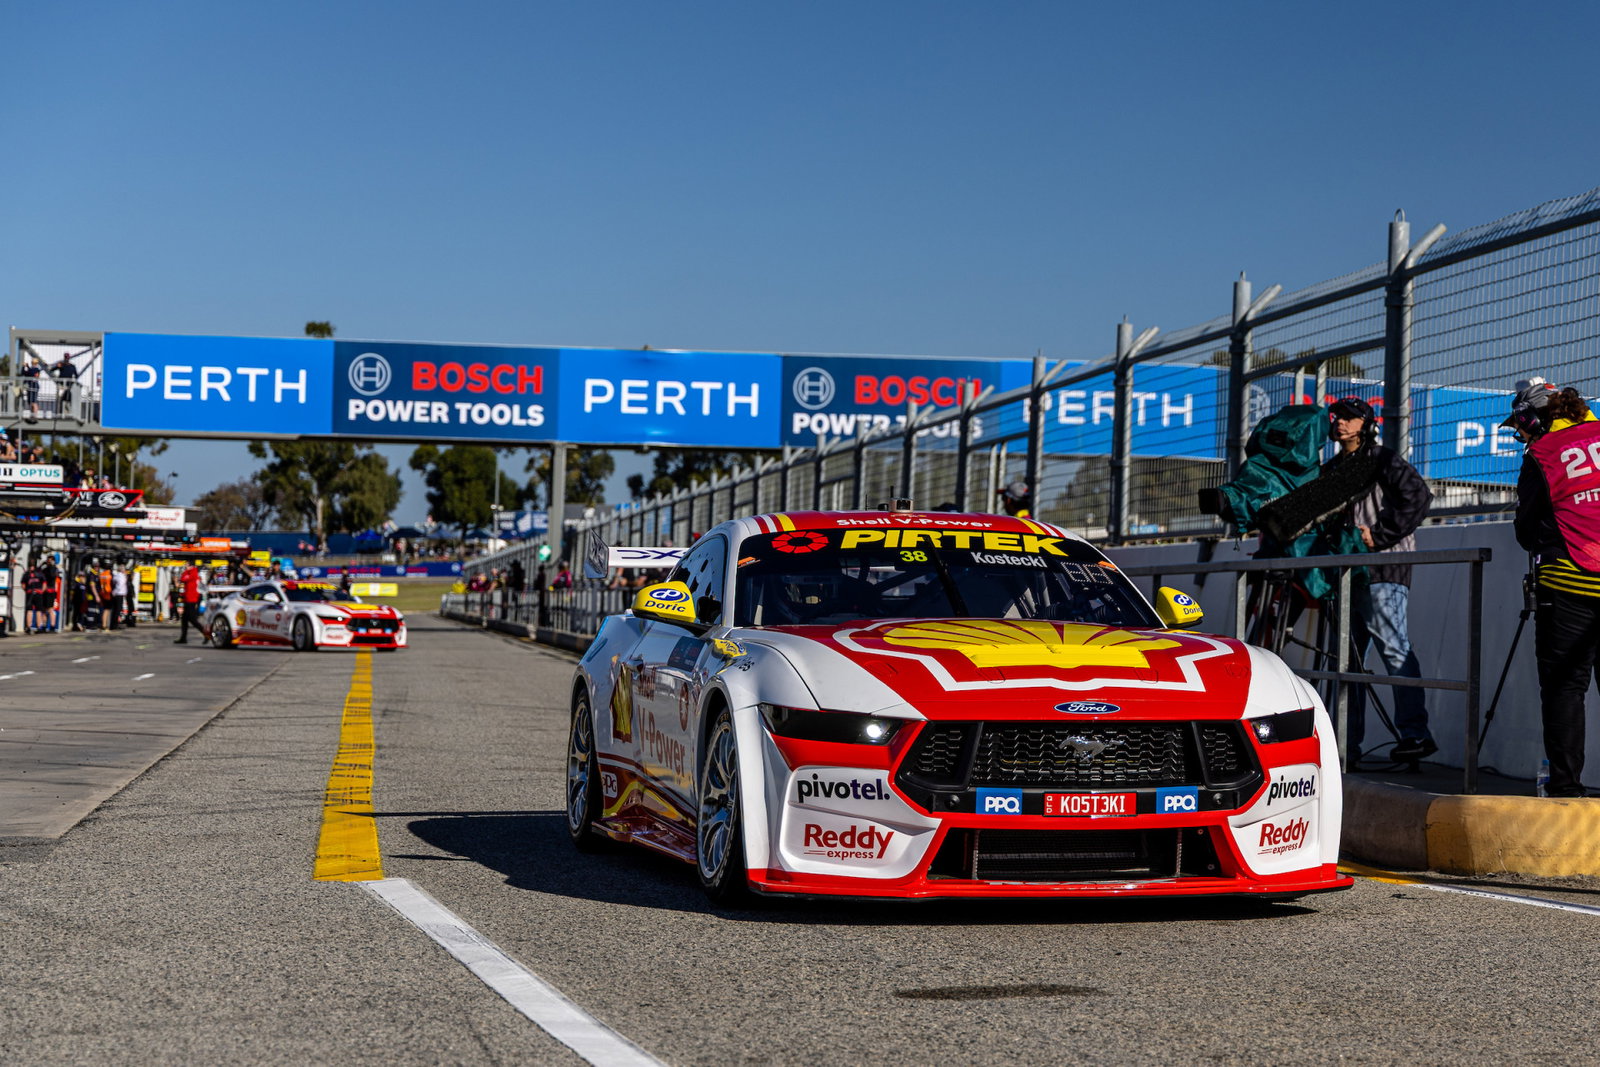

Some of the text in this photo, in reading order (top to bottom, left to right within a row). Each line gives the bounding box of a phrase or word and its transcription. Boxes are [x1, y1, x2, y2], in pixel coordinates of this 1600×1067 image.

[126, 363, 307, 404] PERTH
[411, 361, 543, 395] BOSCH
[584, 378, 759, 417] PERTH
[348, 399, 545, 427] POWER TOOLS
[20, 468, 60, 477] OPTUS
[836, 517, 993, 528] Shell V-Power
[841, 530, 1068, 557] PIRTEK
[901, 550, 928, 562] 38
[972, 552, 1048, 568] Kostecki
[645, 600, 686, 613] Doric
[1067, 702, 1108, 714] Ford
[638, 704, 685, 777] V-Power
[985, 796, 1020, 813] PPQ
[1164, 795, 1197, 811] PPQ
[804, 823, 894, 859] Reddy
[1259, 817, 1310, 849] Reddy
[827, 849, 874, 861] express
[1272, 842, 1298, 855] express
